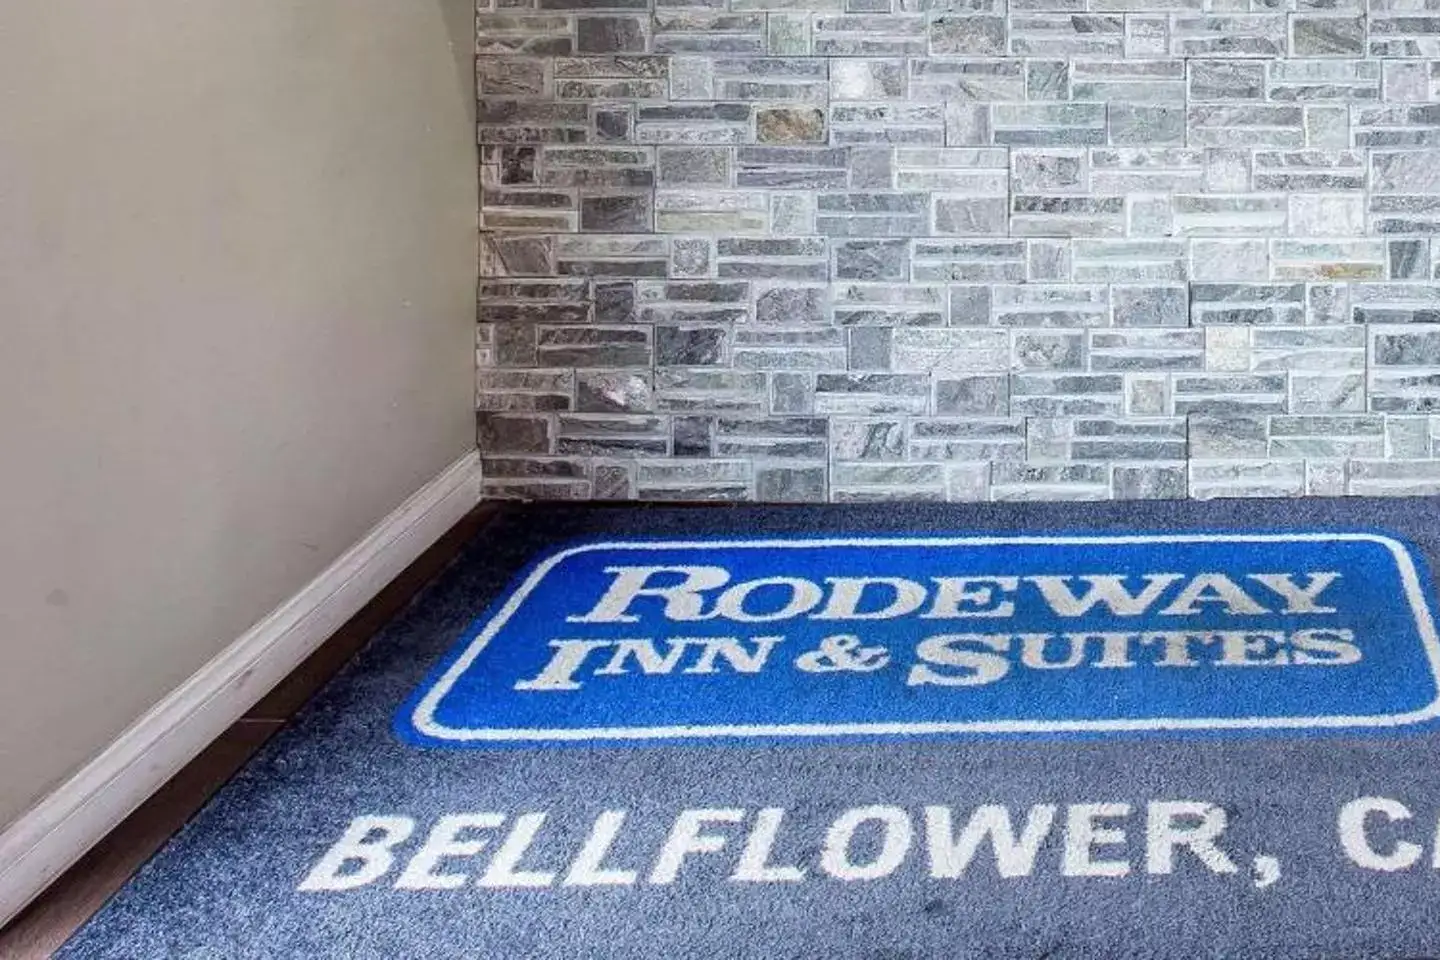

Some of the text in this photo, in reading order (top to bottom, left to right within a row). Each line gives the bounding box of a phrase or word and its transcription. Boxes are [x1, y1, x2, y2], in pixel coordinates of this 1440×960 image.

[566, 565, 1342, 623] RODEWAY
[513, 628, 1363, 691] INN & SUITES
[297, 799, 1281, 889] BELLFLOWER,
